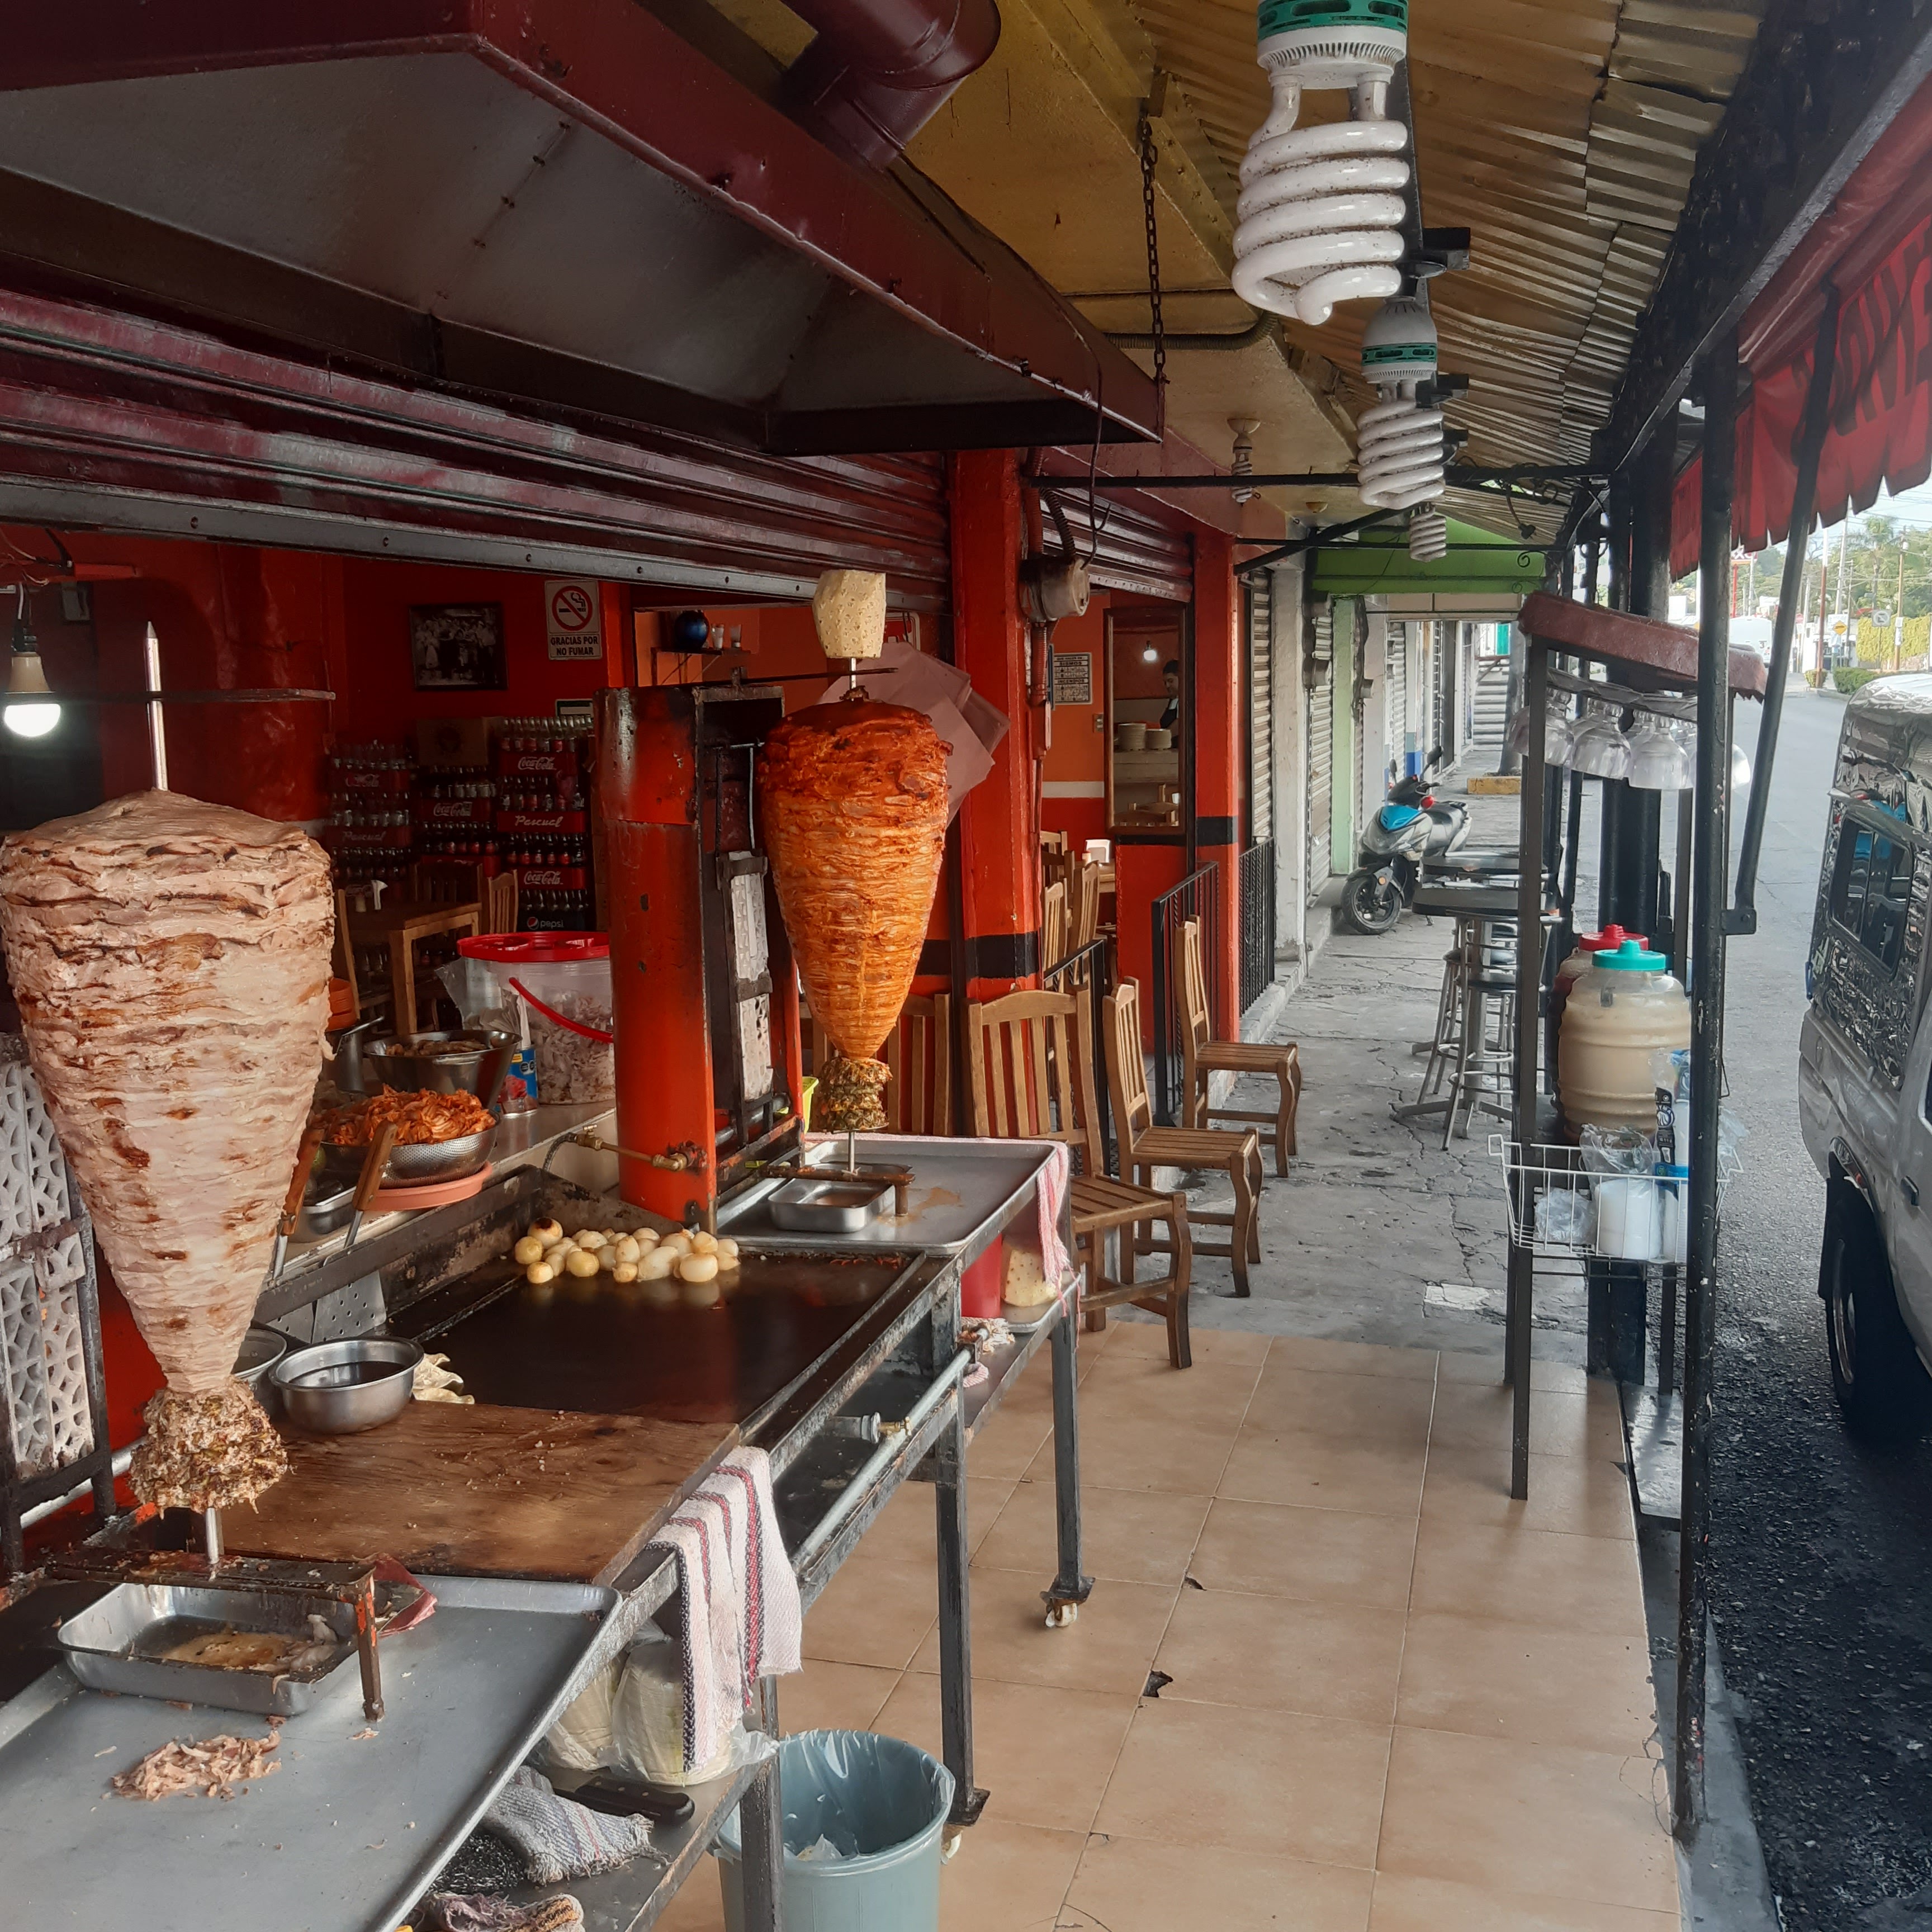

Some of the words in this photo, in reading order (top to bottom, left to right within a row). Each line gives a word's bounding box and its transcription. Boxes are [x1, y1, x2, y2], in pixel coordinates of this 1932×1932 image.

[551, 636, 582, 645] GRACIAS
[584, 636, 598, 645] POR
[556, 647, 567, 656] NO
[569, 647, 594, 655] FUMAR
[518, 756, 557, 770] Coca-Cola
[514, 815, 564, 827] Pascual
[524, 870, 564, 885] Coca-Cola
[540, 920, 564, 930] pepsi
